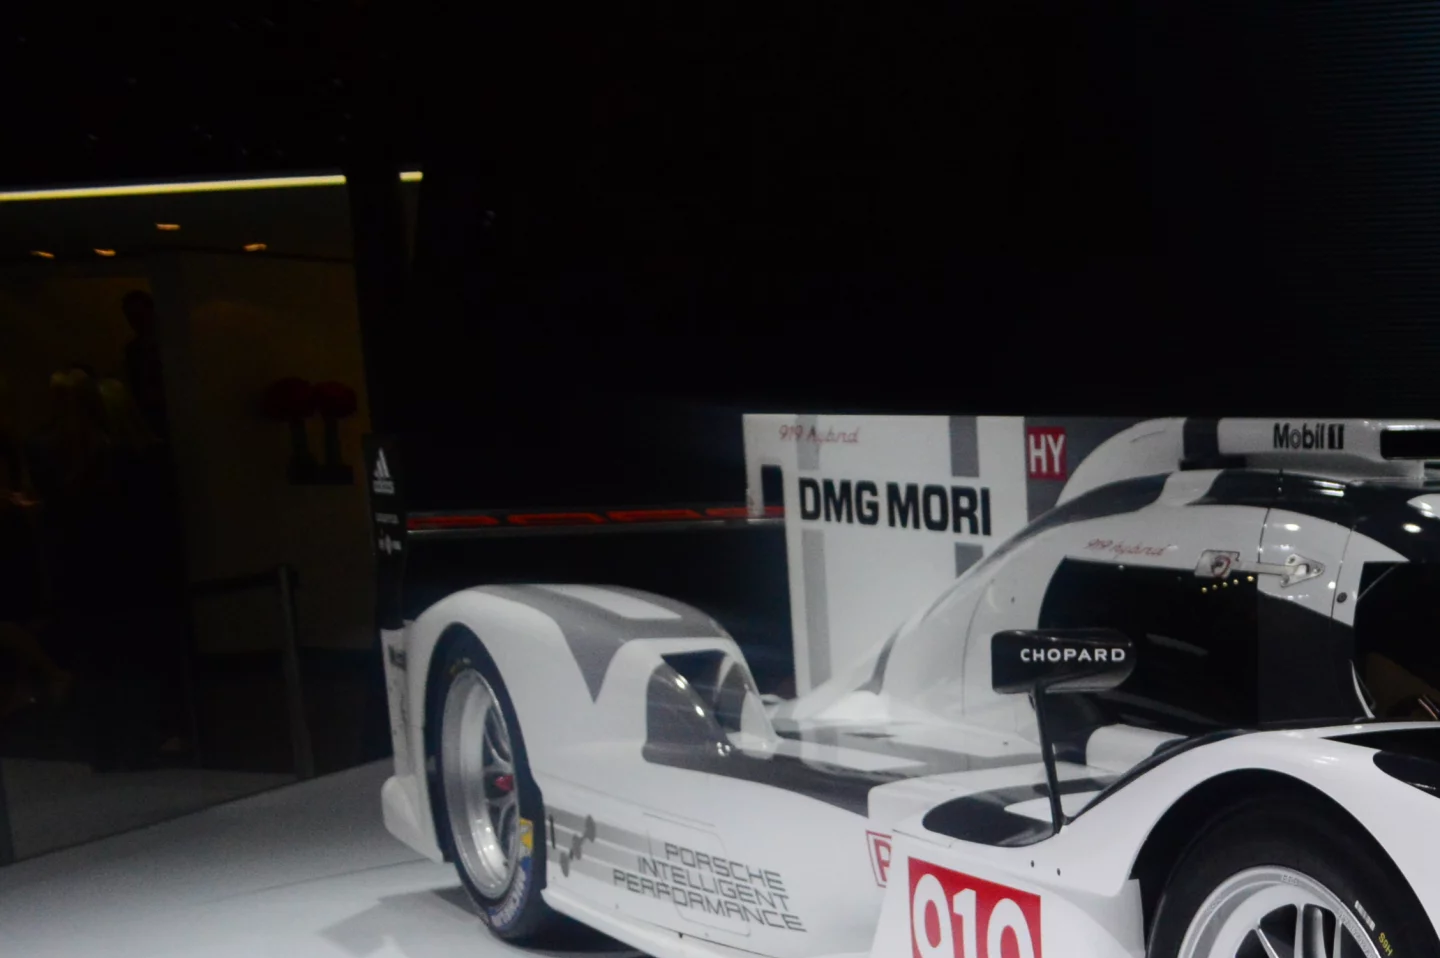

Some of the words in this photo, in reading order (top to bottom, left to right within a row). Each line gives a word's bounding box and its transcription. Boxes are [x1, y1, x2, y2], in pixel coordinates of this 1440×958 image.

[1028, 433, 1065, 475] HY
[1273, 423, 1325, 449] Mobil
[799, 477, 879, 526] DMG
[886, 481, 992, 537] MORI
[1020, 648, 1126, 662] CHOPARD
[637, 856, 790, 911] INTELLIGENT
[664, 842, 787, 892] PORSCHE
[613, 868, 807, 933] PERFORMANCE
